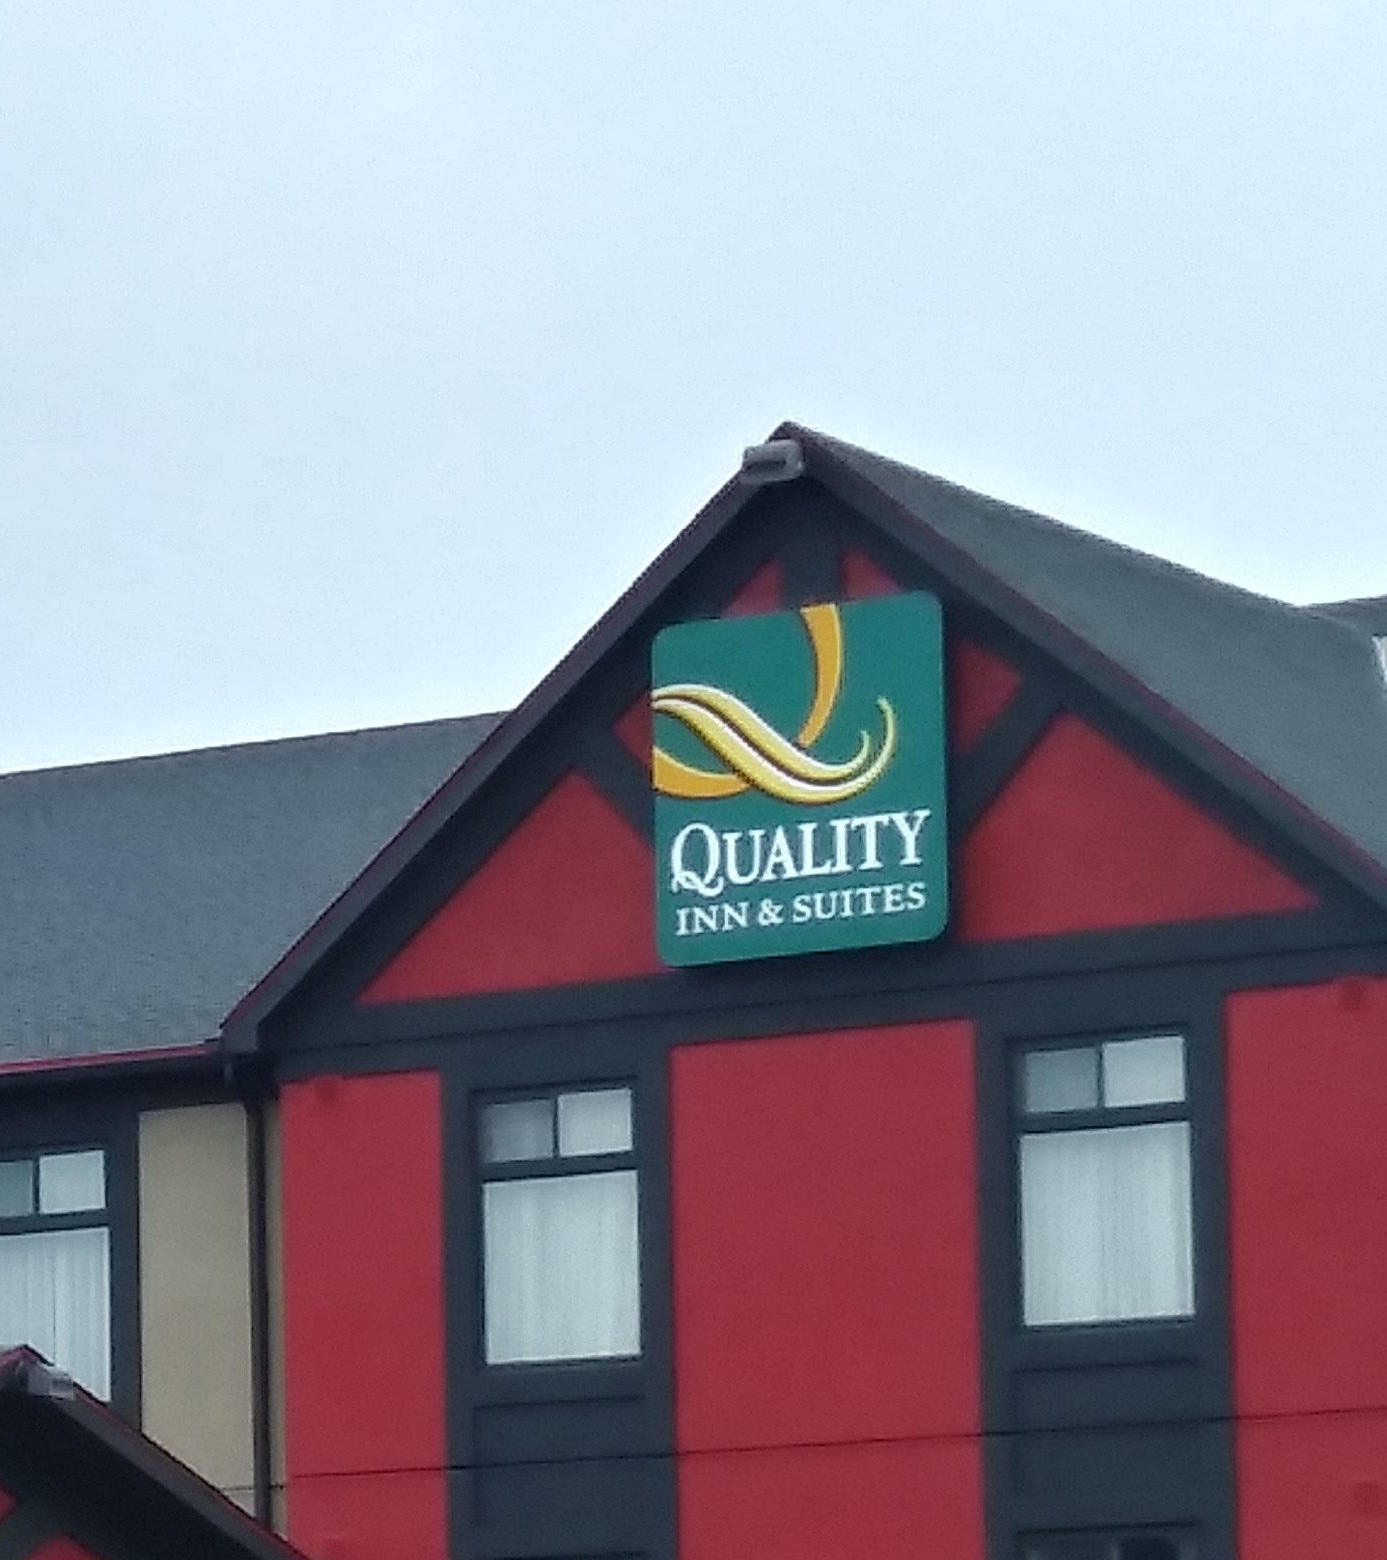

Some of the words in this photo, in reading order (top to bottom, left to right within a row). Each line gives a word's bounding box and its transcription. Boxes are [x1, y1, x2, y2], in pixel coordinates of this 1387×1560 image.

[671, 809, 931, 897] QUALITY
[675, 900, 749, 936] INN
[758, 899, 783, 926] &
[792, 882, 926, 922] SUITES
